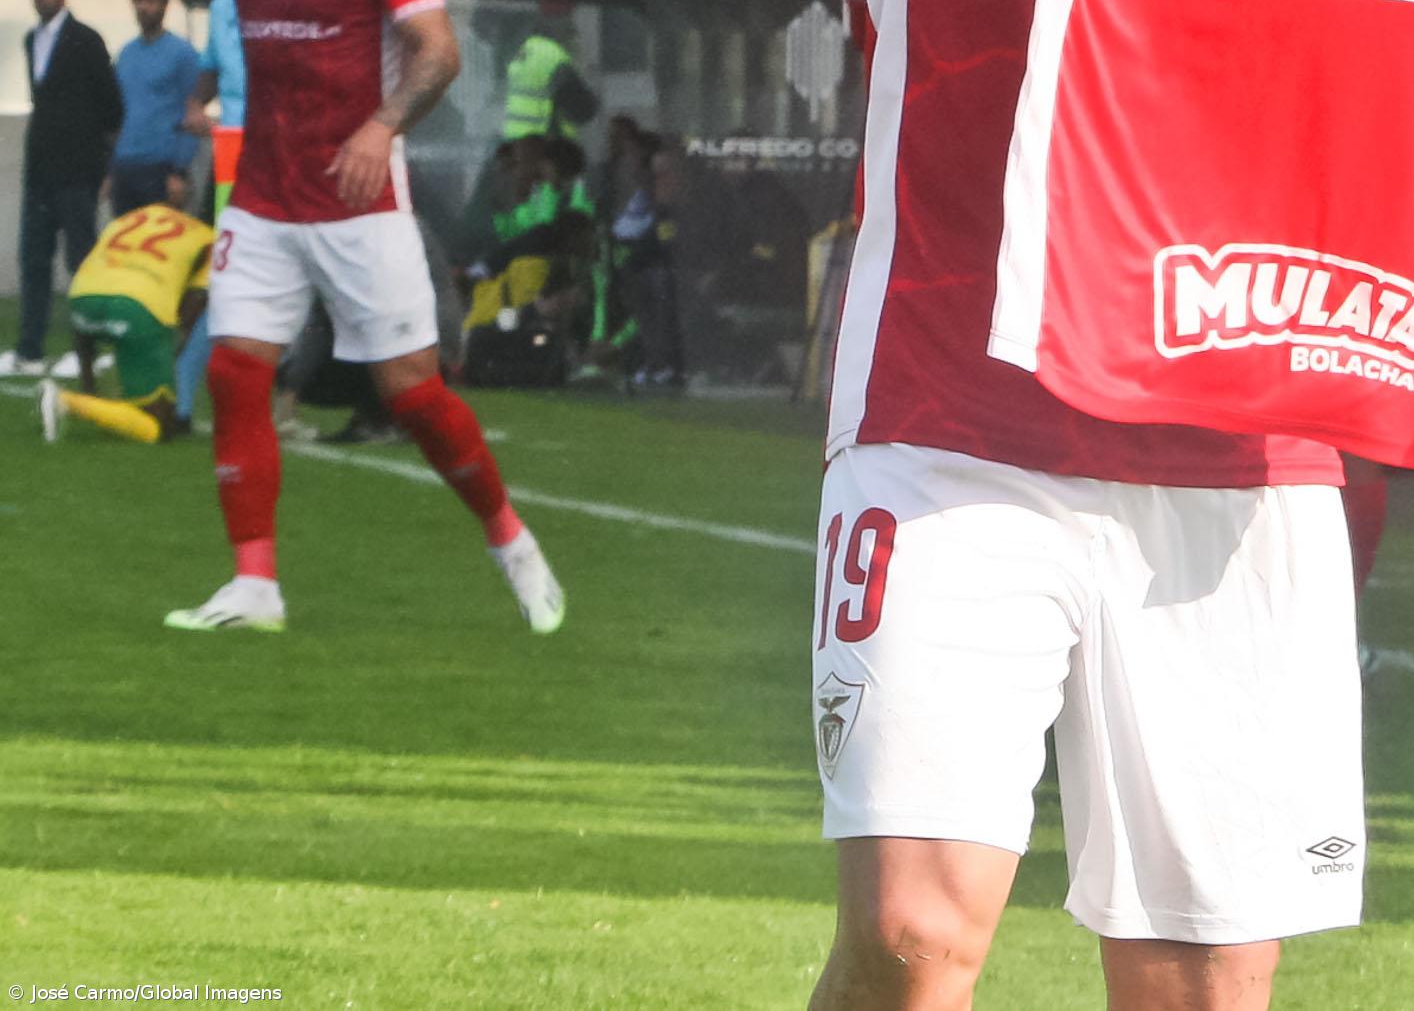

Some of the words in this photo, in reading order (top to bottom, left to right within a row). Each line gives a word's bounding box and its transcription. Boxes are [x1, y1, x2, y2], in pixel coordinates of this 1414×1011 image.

[107, 213, 186, 261] 22
[818, 507, 897, 651] 19
[1312, 861, 1355, 875] umbro
